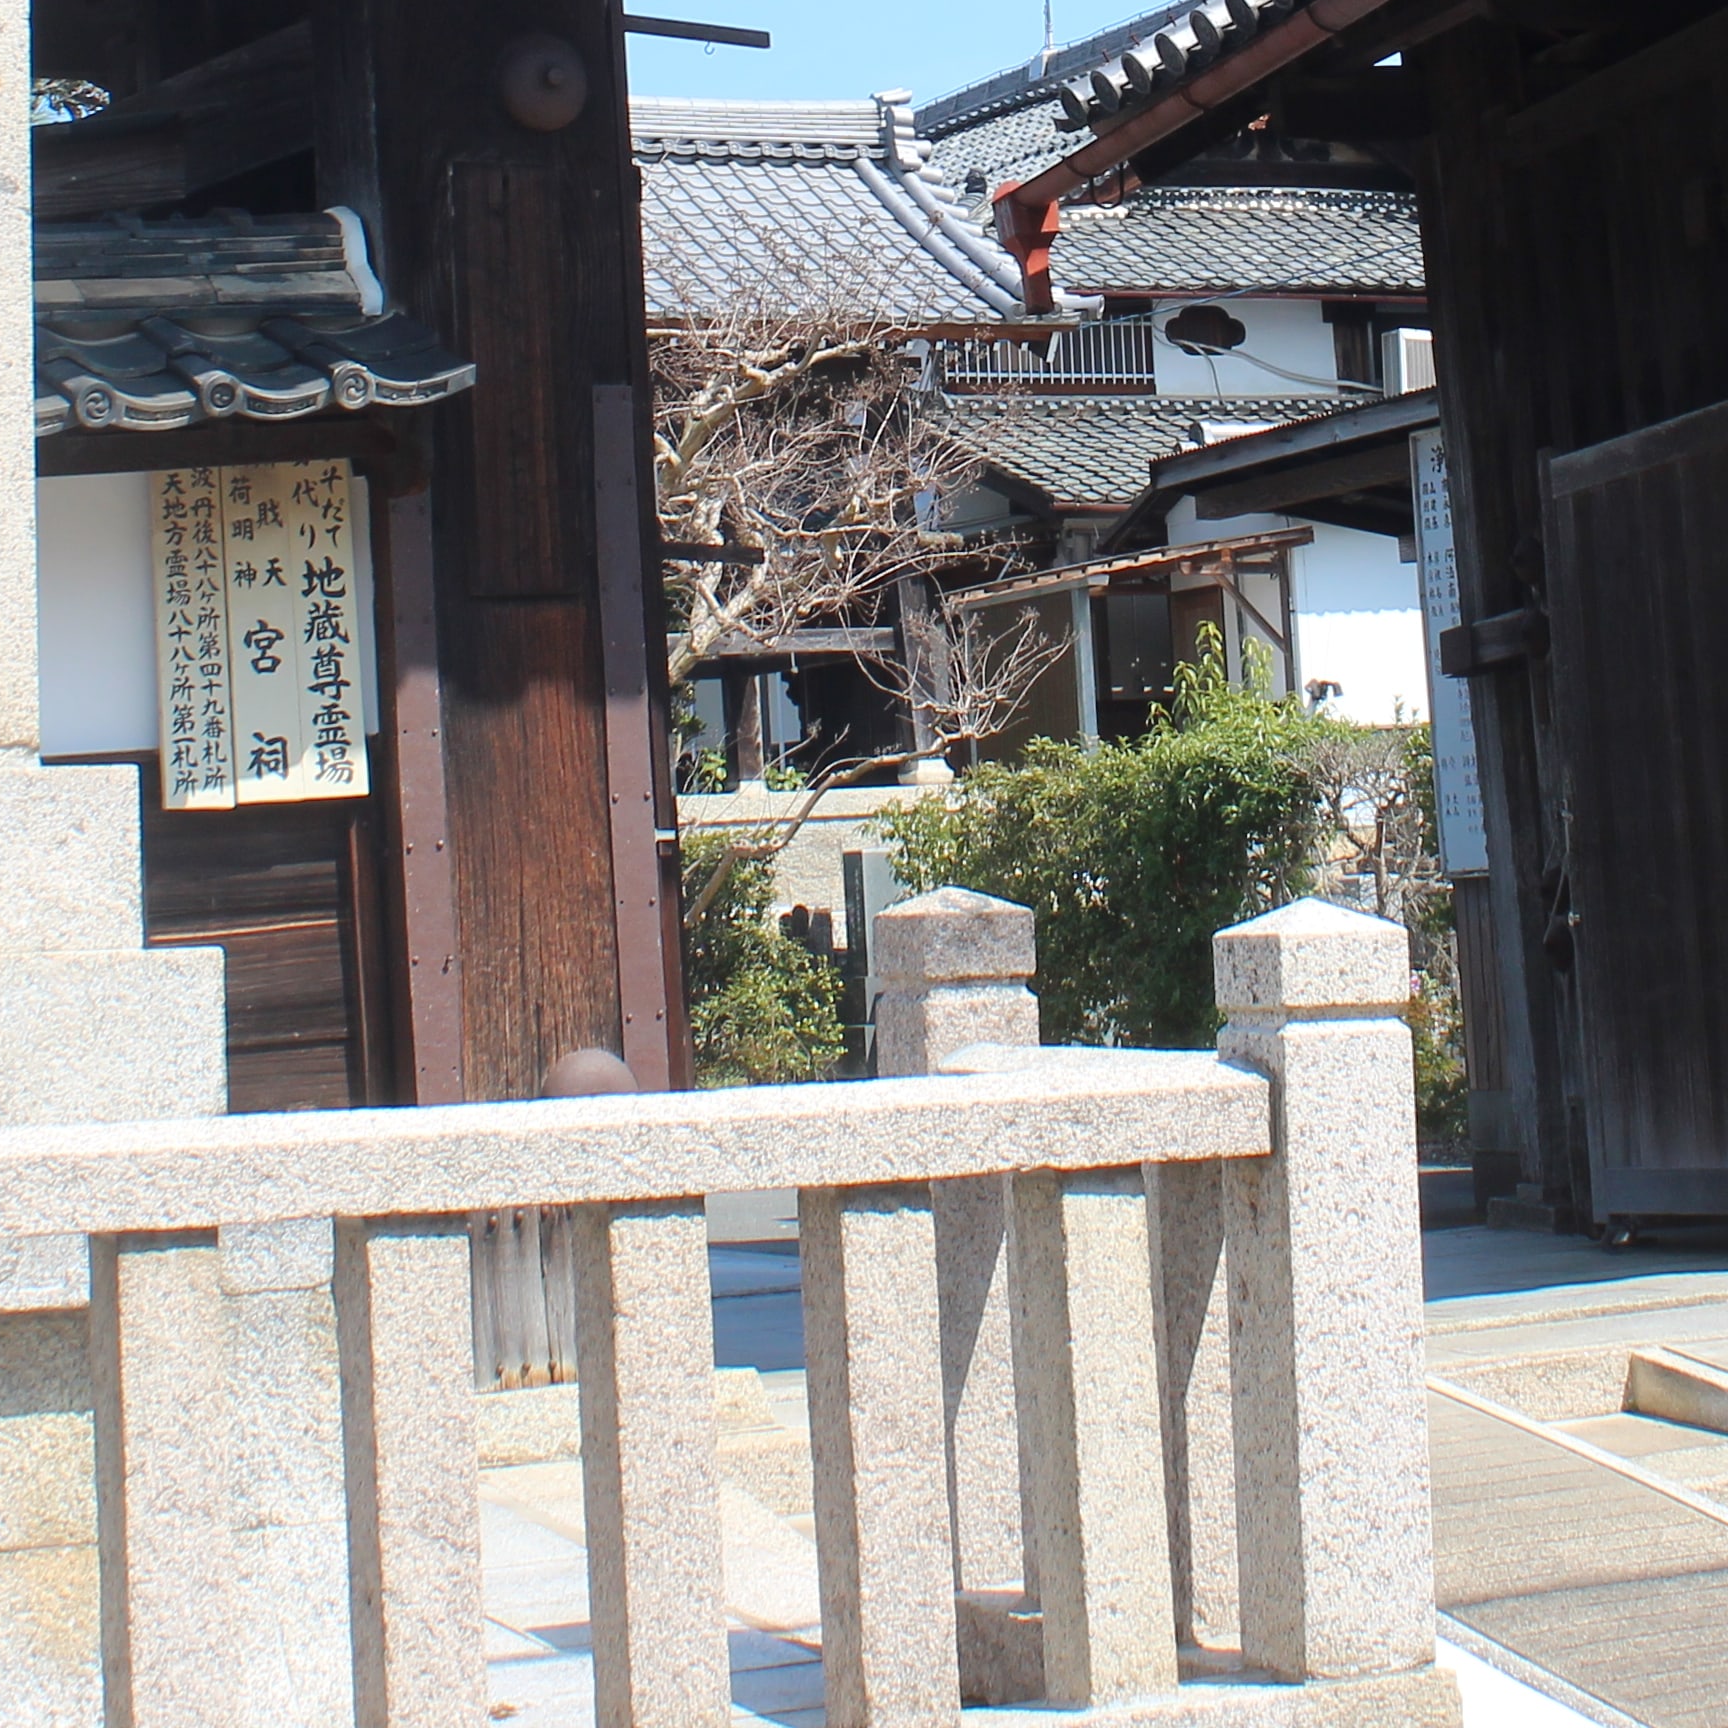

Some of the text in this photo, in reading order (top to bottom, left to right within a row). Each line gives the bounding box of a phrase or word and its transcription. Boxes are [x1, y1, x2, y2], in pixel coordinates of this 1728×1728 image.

[320, 458, 345, 549] そだて
[301, 556, 353, 785] 地蔵尊霊場
